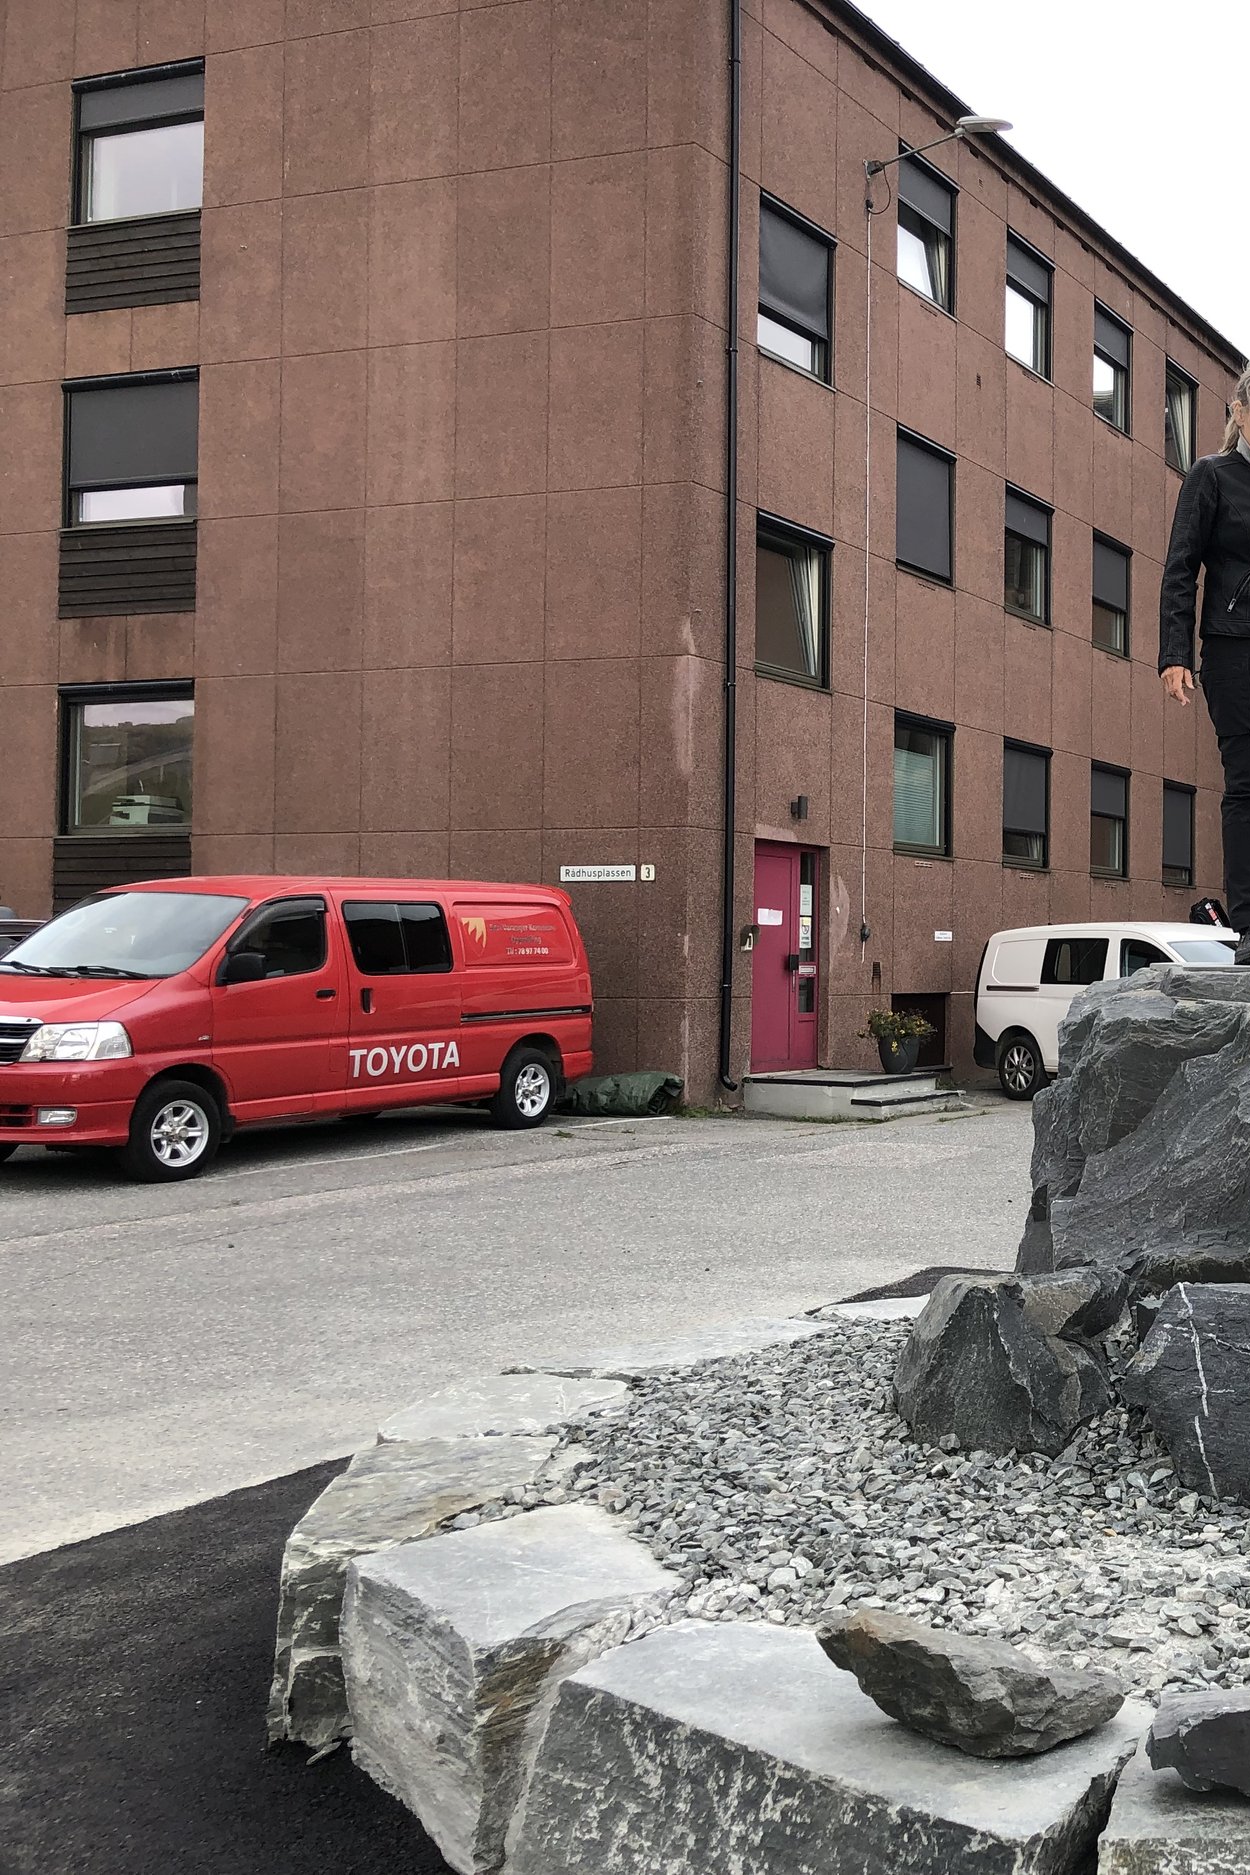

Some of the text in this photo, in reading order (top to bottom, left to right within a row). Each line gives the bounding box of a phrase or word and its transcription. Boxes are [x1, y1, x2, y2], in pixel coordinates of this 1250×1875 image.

[564, 867, 651, 879] Rådhusplassen 3
[349, 1041, 460, 1078] TOYOTA
